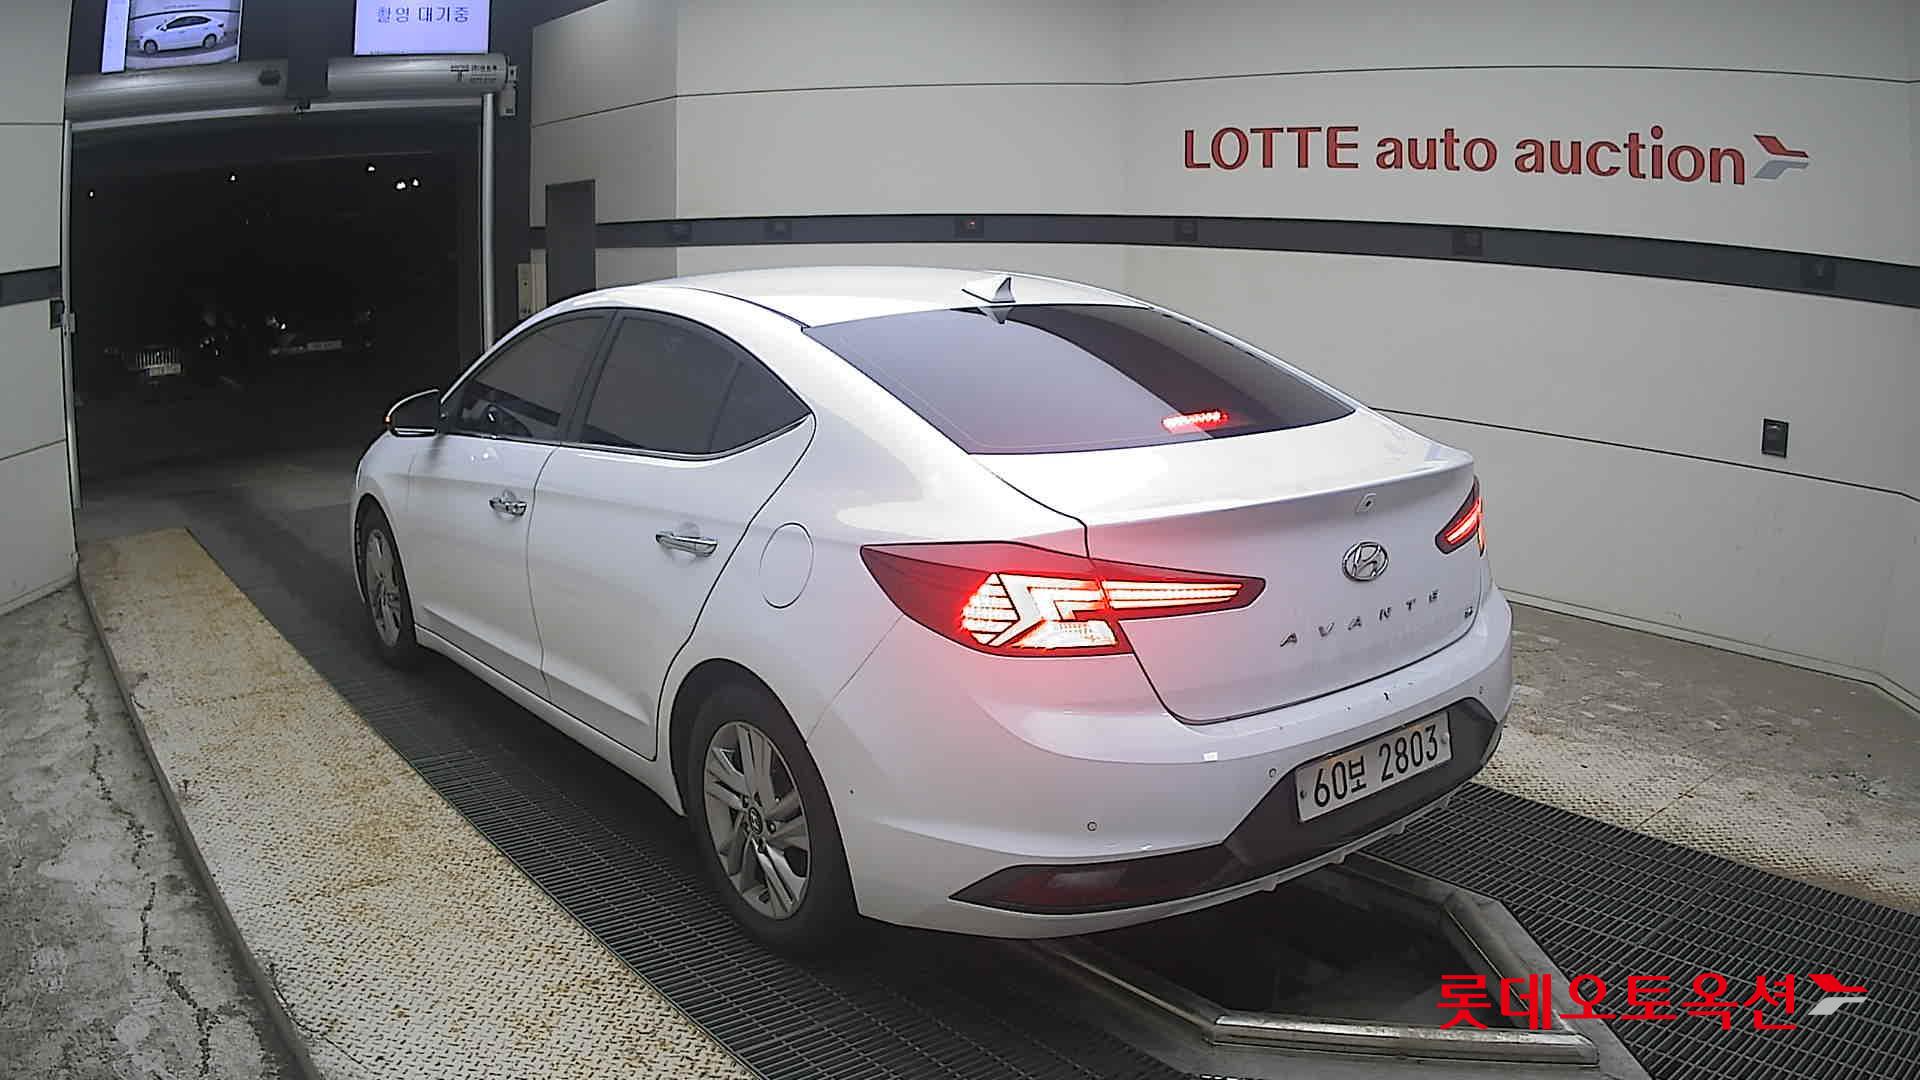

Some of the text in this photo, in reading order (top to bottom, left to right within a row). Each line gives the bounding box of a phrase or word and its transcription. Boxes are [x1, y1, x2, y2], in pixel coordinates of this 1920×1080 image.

[418, 6, 470, 23] 대기중
[1183, 124, 1746, 186] LOTTE auto auction
[1279, 588, 1440, 648] AVANTE
[1313, 723, 1439, 808] 60보 2803
